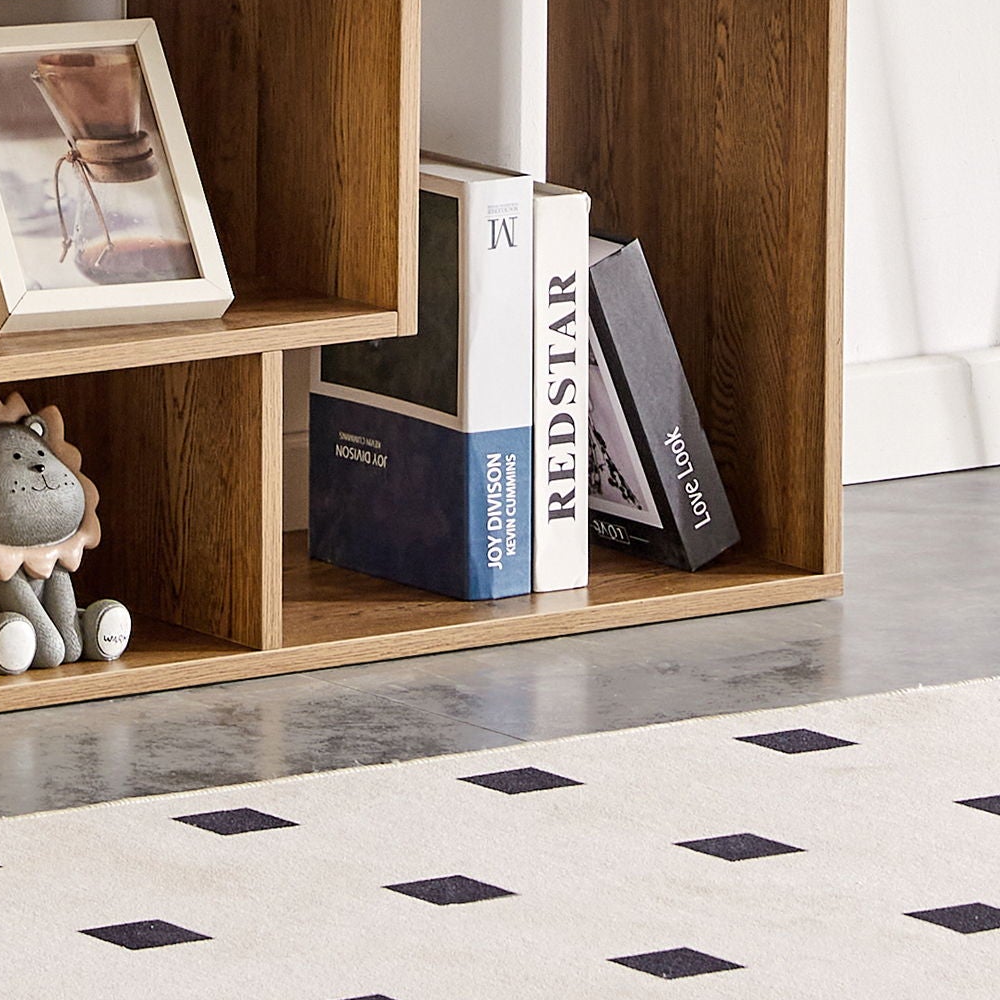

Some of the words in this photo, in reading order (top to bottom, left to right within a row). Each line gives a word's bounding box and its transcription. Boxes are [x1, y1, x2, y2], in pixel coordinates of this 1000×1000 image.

[487, 216, 518, 251] M
[335, 443, 371, 464] DIVISON
[371, 453, 388, 469] JOY
[663, 425, 694, 480] Look
[486, 453, 503, 531] DIVISON
[505, 453, 517, 516] CUMMINS
[685, 478, 711, 530] Love
[487, 535, 503, 570] JOY
[505, 518, 517, 556] KEVIN
